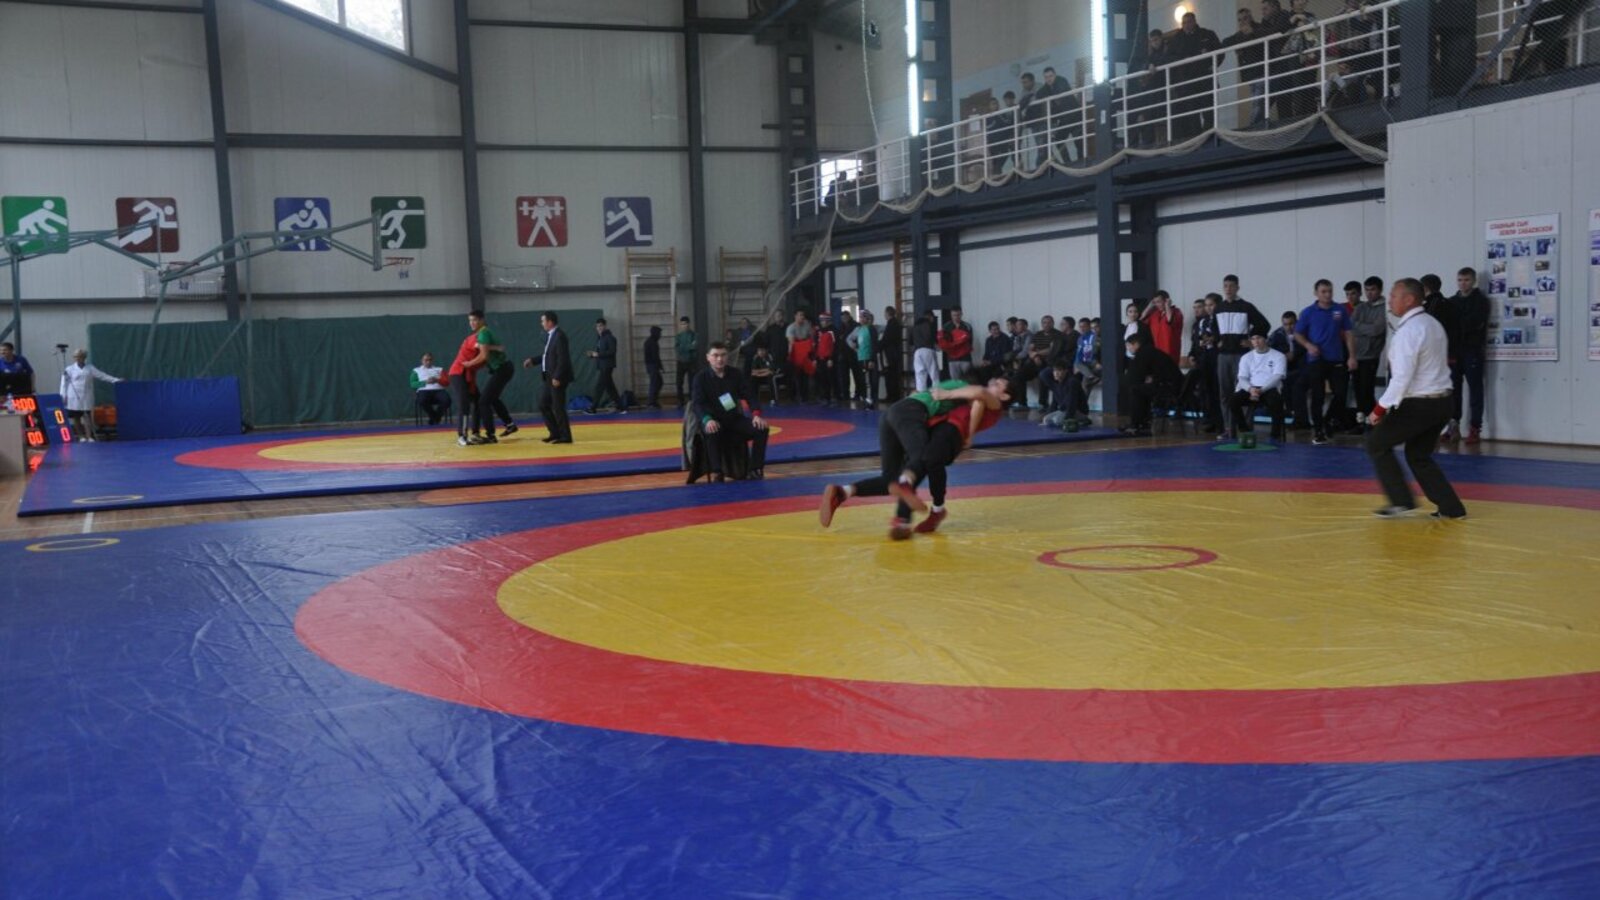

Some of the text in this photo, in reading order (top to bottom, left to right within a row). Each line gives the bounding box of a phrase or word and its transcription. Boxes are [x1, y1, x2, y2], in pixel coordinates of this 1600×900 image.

[54, 410, 65, 424] 0
[27, 431, 44, 446] 00
[60, 427, 71, 442] 0
